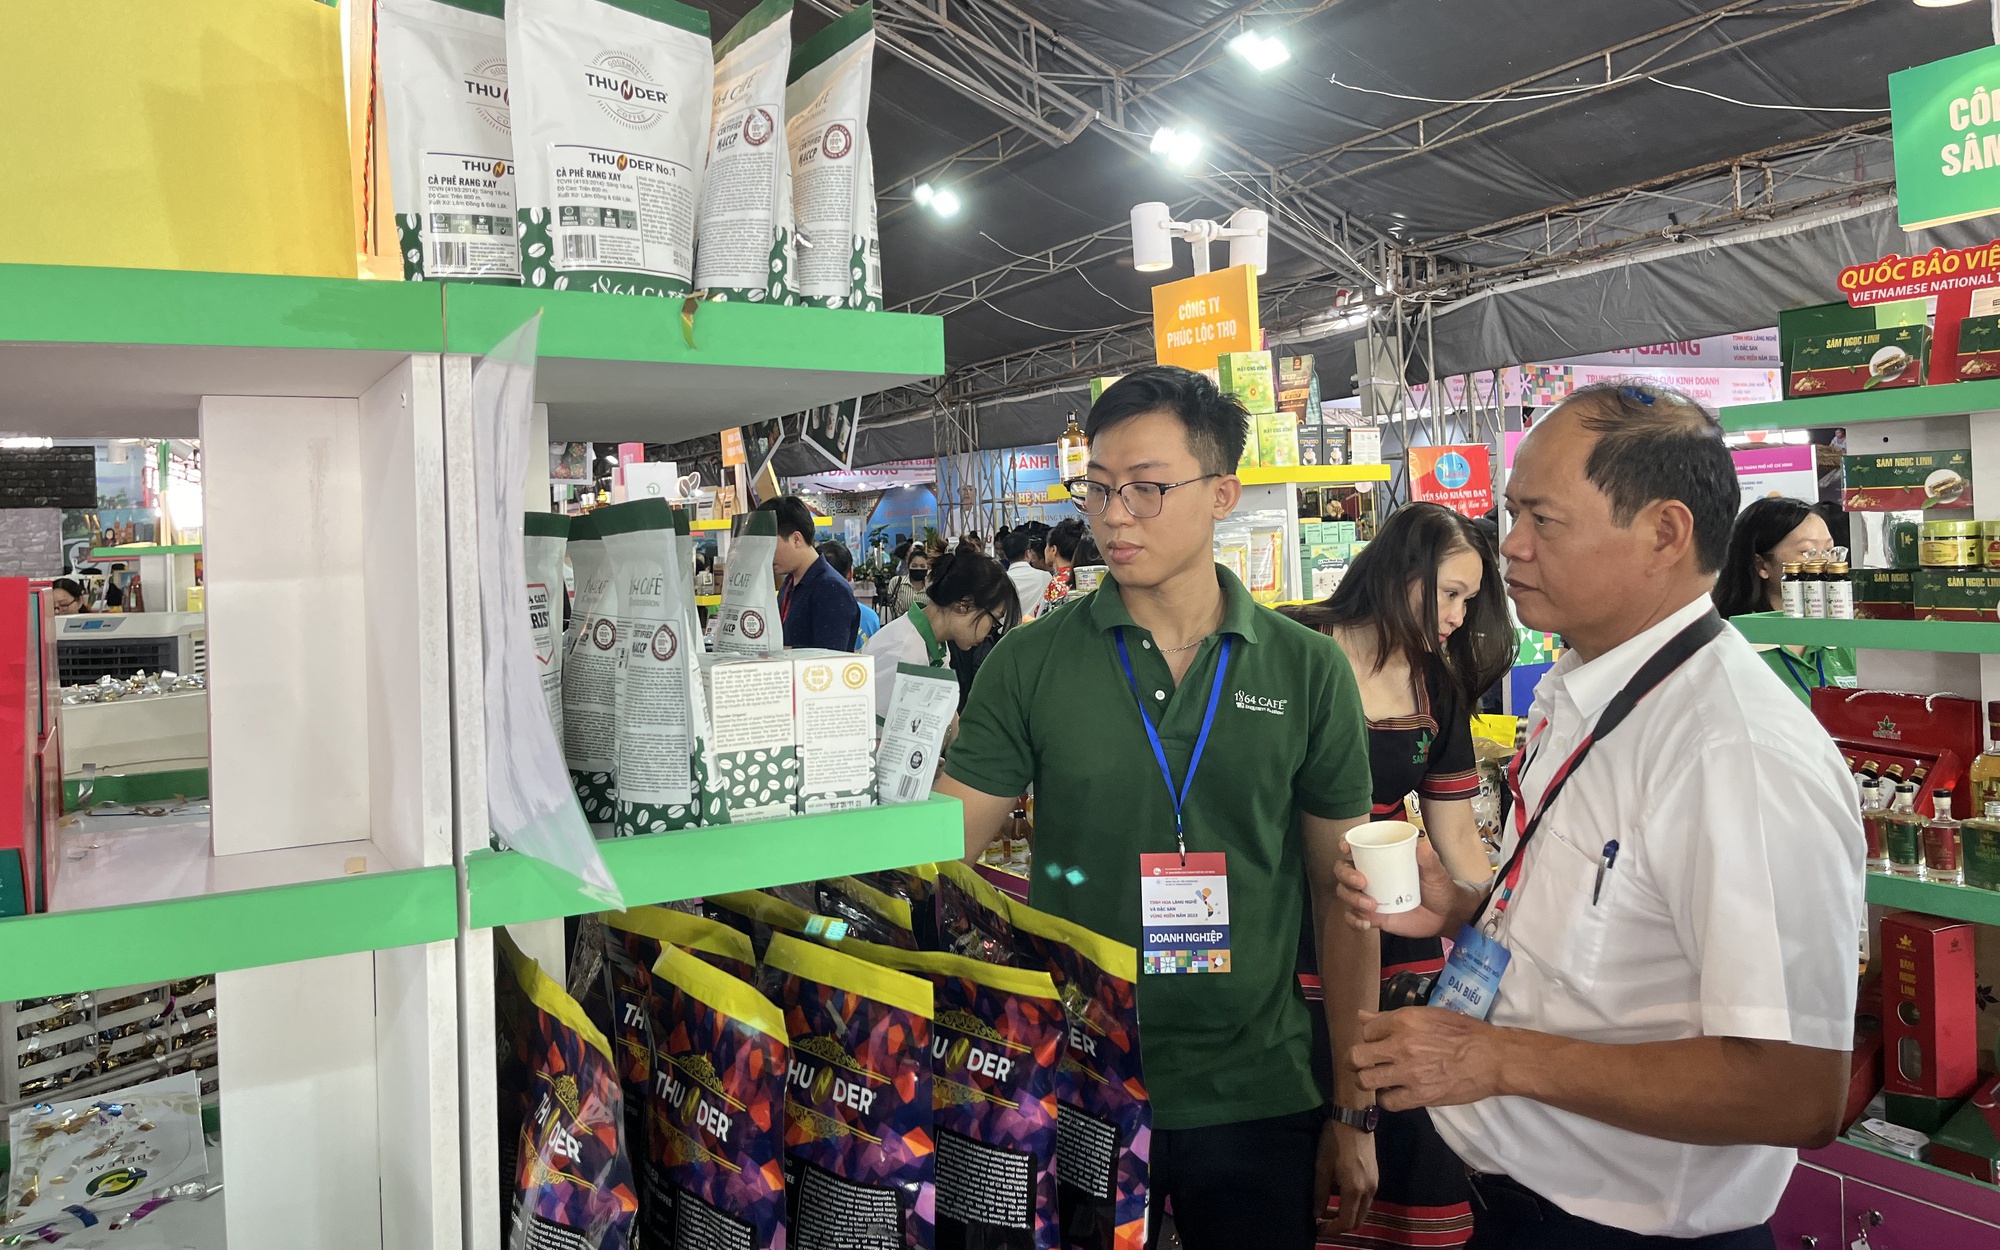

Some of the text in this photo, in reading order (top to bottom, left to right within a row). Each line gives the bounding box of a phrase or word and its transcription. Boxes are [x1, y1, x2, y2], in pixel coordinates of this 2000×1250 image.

[585, 72, 668, 104] THUNDER
[556, 166, 621, 181] CÀ PHÊ RANG XAY
[588, 152, 676, 177] THUNDER No.1
[428, 174, 497, 188] CÀ PHÊ RANG XAY
[1841, 244, 2000, 289] QUỐC BẢO VIỆ
[1852, 276, 1994, 302] VIETNAMESE NATIONAL
[1178, 296, 1220, 321] CÔNG TY
[1167, 320, 1237, 349] PHÚC LỘC THỌ
[1844, 336, 1862, 347] NGỌC
[1864, 334, 1880, 345] LINH
[1676, 376, 1694, 385] KINH
[1695, 376, 1719, 385] DOANH
[1692, 389, 1711, 399] (BSA)
[1009, 452, 1050, 469] BÁNH
[1895, 458, 1914, 468] NGỌC
[1916, 456, 1933, 466] LINH
[1965, 577, 1986, 589] NGỌC
[1234, 690, 1256, 704] 1864
[1150, 930, 1223, 944] DOANH NGHIỆP
[1448, 976, 1463, 993] ĐẠI
[1463, 987, 1481, 1005] BIỂU
[932, 1035, 1015, 1083] UNDER
[786, 1058, 877, 1116] HUNDER
[655, 1070, 733, 1143] THUNDER
